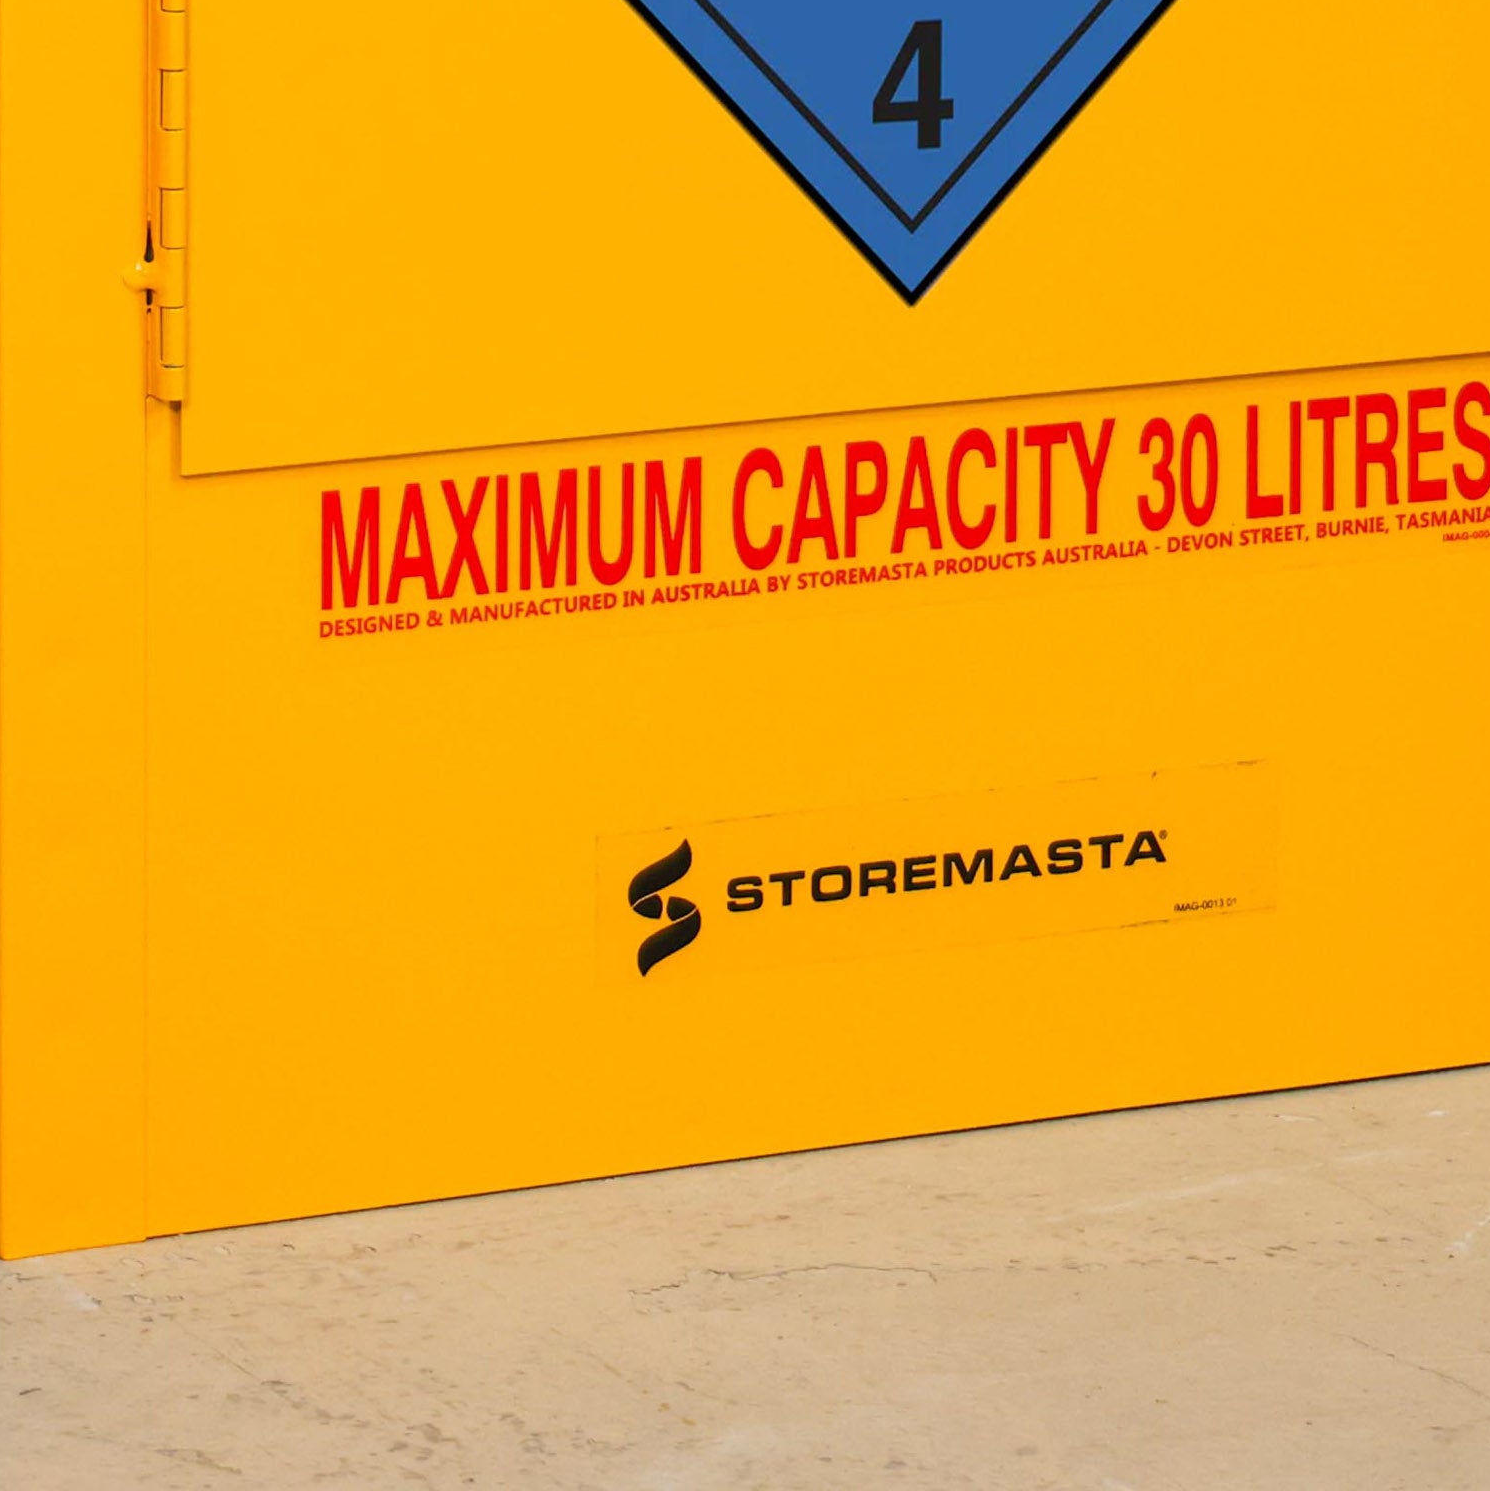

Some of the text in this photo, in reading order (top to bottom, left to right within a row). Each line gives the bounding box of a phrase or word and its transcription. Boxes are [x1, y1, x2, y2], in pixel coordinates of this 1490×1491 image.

[873, 20, 953, 149] 4
[320, 456, 704, 610] MAXIMUM
[732, 417, 1117, 570] CAPACITY
[1138, 413, 1218, 532] 30
[320, 613, 420, 638] DESIGNED
[427, 610, 443, 627] &
[447, 589, 617, 624] MANUFACTURED
[623, 590, 644, 607] IN
[651, 578, 760, 604] AUSTRALIA
[767, 575, 791, 592] BY
[798, 553, 927, 590] STOREMASTA
[934, 551, 1036, 575] PRODUCTS
[1042, 540, 1148, 565] AUSTRALIA
[1167, 531, 1233, 553] DEVON
[1240, 524, 1309, 546] STREET,
[1317, 516, 1389, 538] BURNIE,
